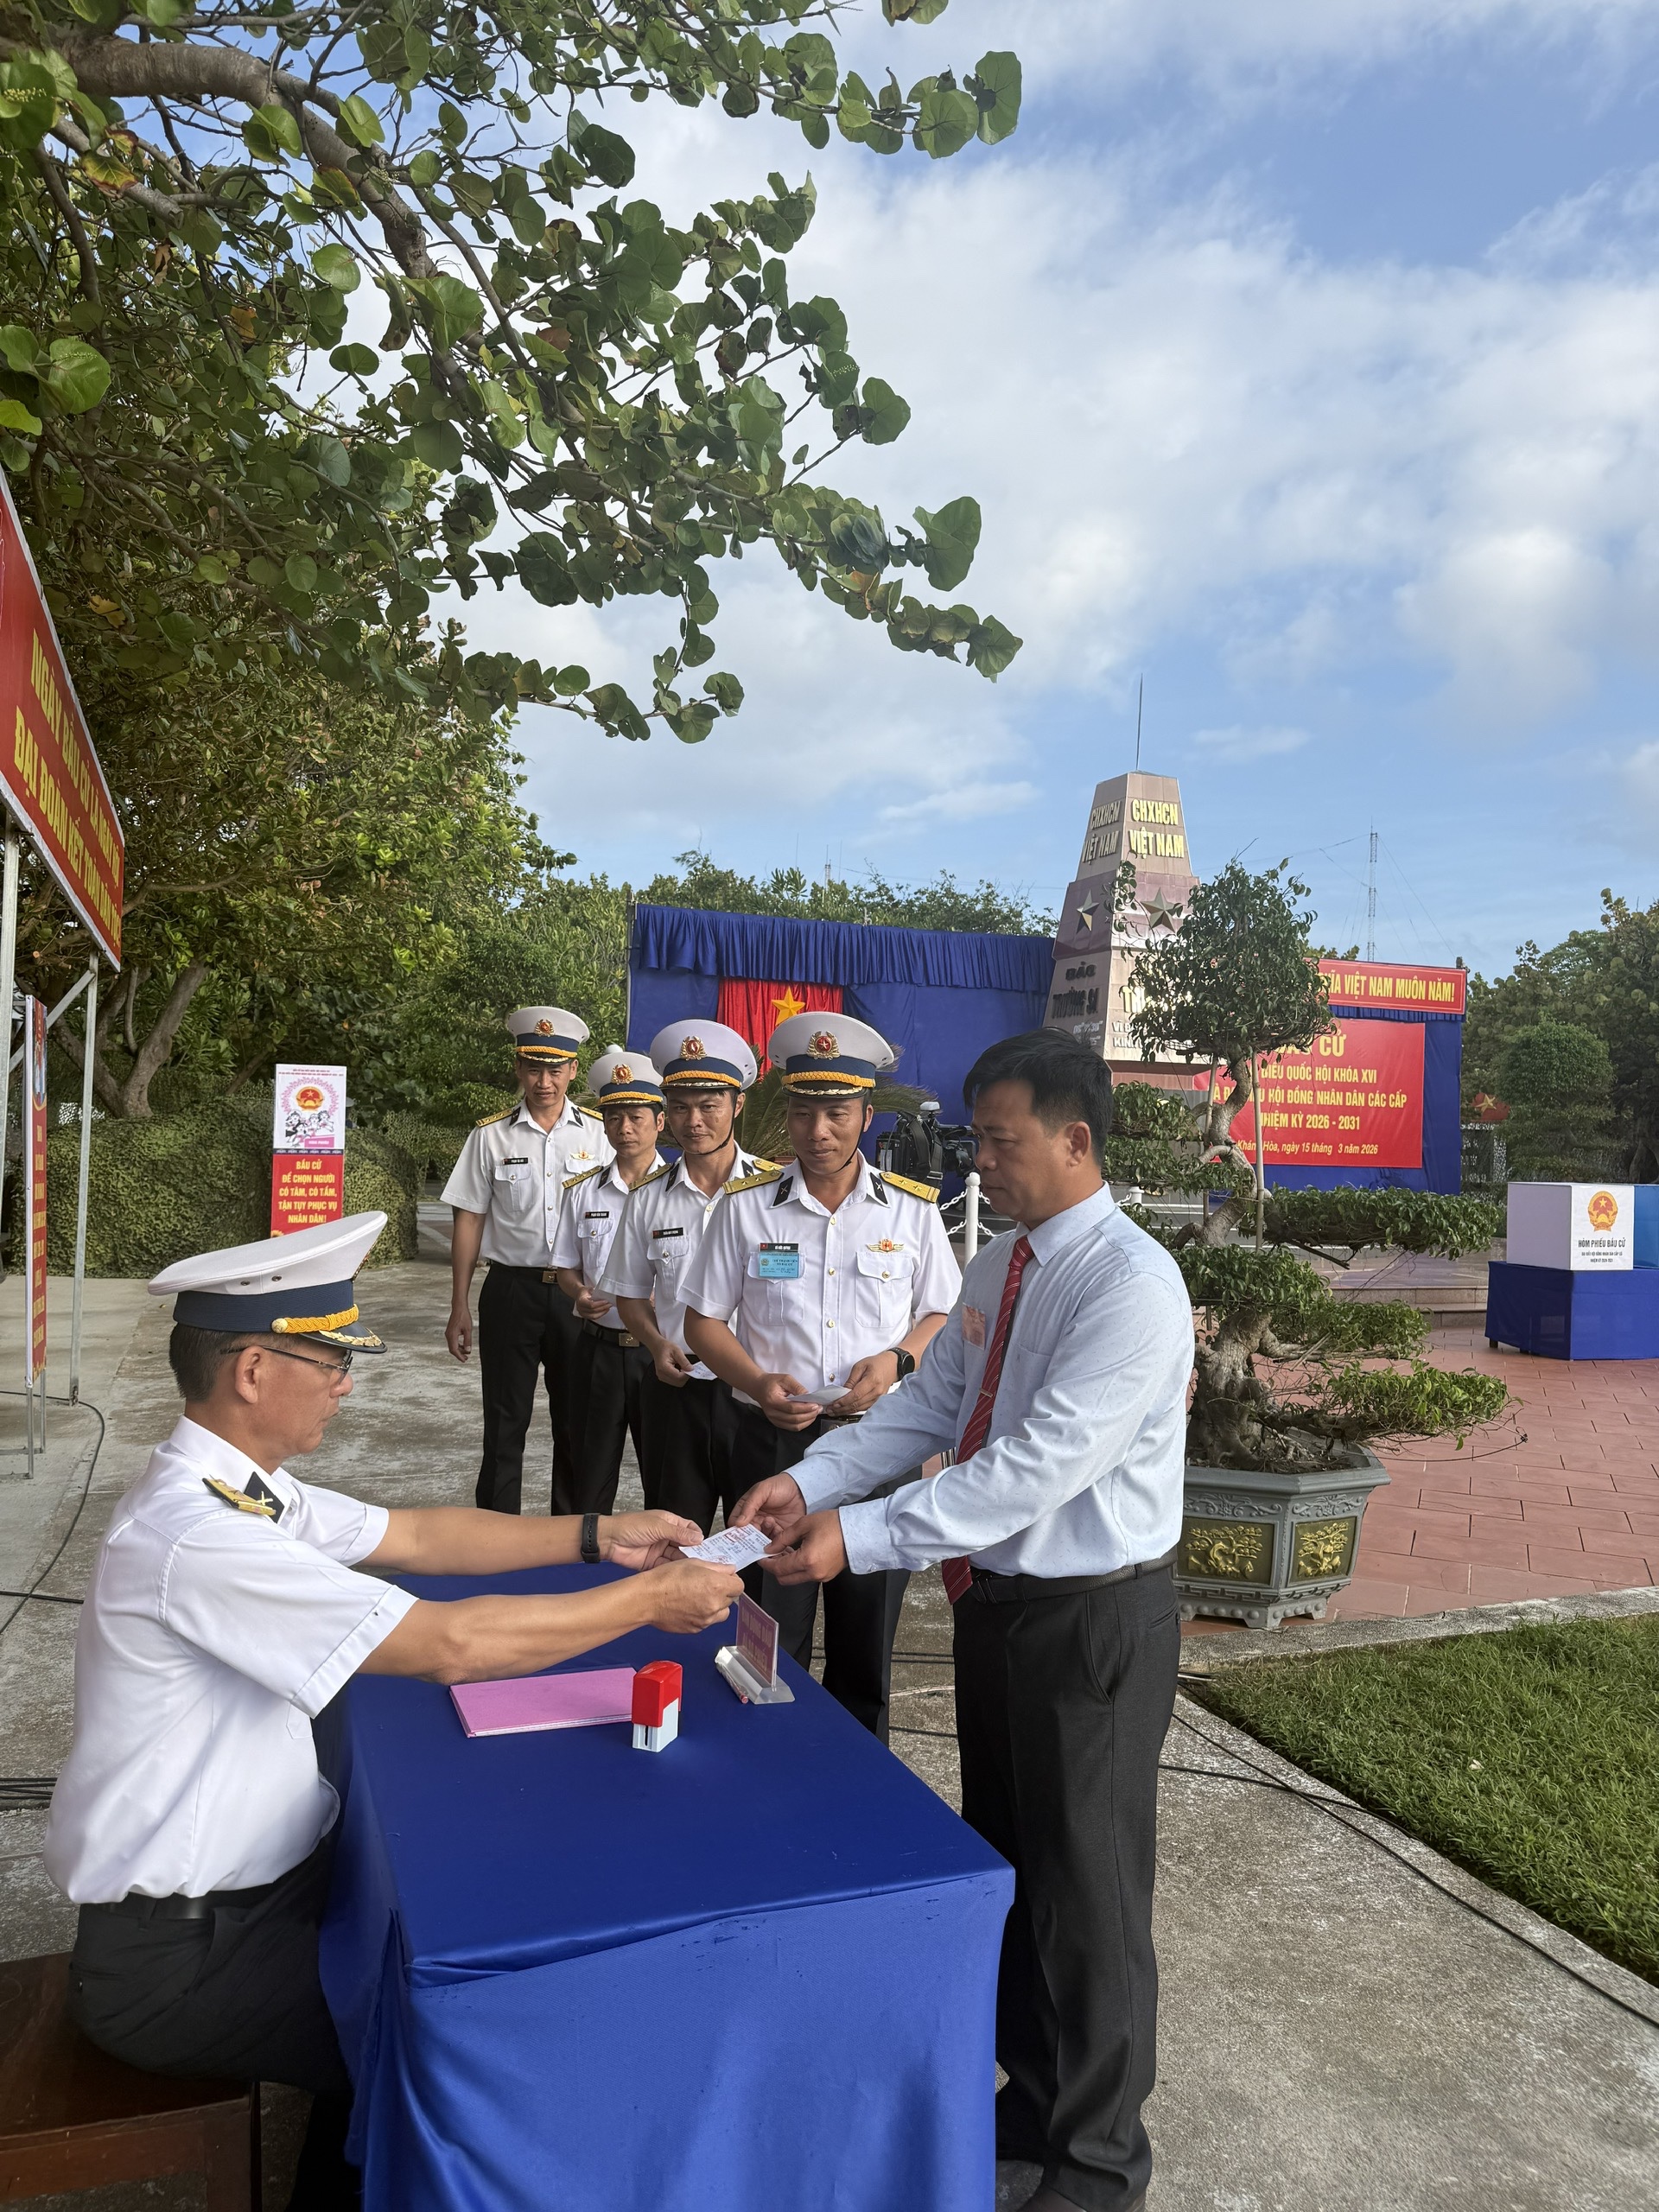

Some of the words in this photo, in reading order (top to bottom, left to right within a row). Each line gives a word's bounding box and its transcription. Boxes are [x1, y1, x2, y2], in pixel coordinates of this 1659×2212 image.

[31, 628, 62, 745] NGÀY
[14, 705, 39, 799] ĐẠI
[39, 755, 68, 853] ĐOÀN
[67, 816, 85, 880] KẾT
[1090, 800, 1122, 830] CHXHCN
[1131, 798, 1179, 825] CHXHCN
[1082, 834, 1099, 865] VIỆT
[1098, 830, 1120, 858] NAM
[1128, 826, 1154, 859] VIỆT
[1155, 832, 1185, 858] NAM
[1344, 970, 1367, 1000] VIỆT
[1369, 976, 1393, 998] NAM
[1395, 976, 1427, 1001] MUÔN
[1428, 977, 1455, 1002] NĂM!
[1319, 1029, 1347, 1057] CỬ
[1287, 1062, 1312, 1081] QUỐC
[1315, 1063, 1332, 1085] HỘI
[1333, 1065, 1359, 1084] KHÓA
[1361, 1069, 1377, 1084] XVI
[1268, 1086, 1285, 1106] HỘI
[1287, 1085, 1313, 1103] ĐỒNG
[1316, 1088, 1344, 1105] NHÂN
[1345, 1089, 1365, 1106] DÂN
[1368, 1091, 1387, 1108] CÁC
[1389, 1089, 1408, 1109] CẤP
[1291, 1110, 1304, 1128] KỲ
[1306, 1116, 1330, 1129] 2026
[1338, 1116, 1360, 1130] 2031
[1237, 1140, 1256, 1151] Khán
[1262, 1141, 1280, 1153] Hòa,
[1281, 1142, 1299, 1155] ngày
[1301, 1142, 1309, 1153] 15
[1311, 1142, 1332, 1155] tháng
[1338, 1143, 1344, 1154] 3
[1344, 1143, 1359, 1154] năm
[1361, 1144, 1378, 1154] 2026
[293, 1174, 312, 1185] CHỌN
[313, 1173, 335, 1183] NGƯỜI
[279, 1186, 289, 1197] CÓ
[308, 1186, 318, 1197] CÓ
[288, 1213, 308, 1224] NHÂN
[308, 1202, 327, 1211] PHỤC
[328, 1202, 337, 1211] VỤ
[1578, 1237, 1590, 1248] HÒM
